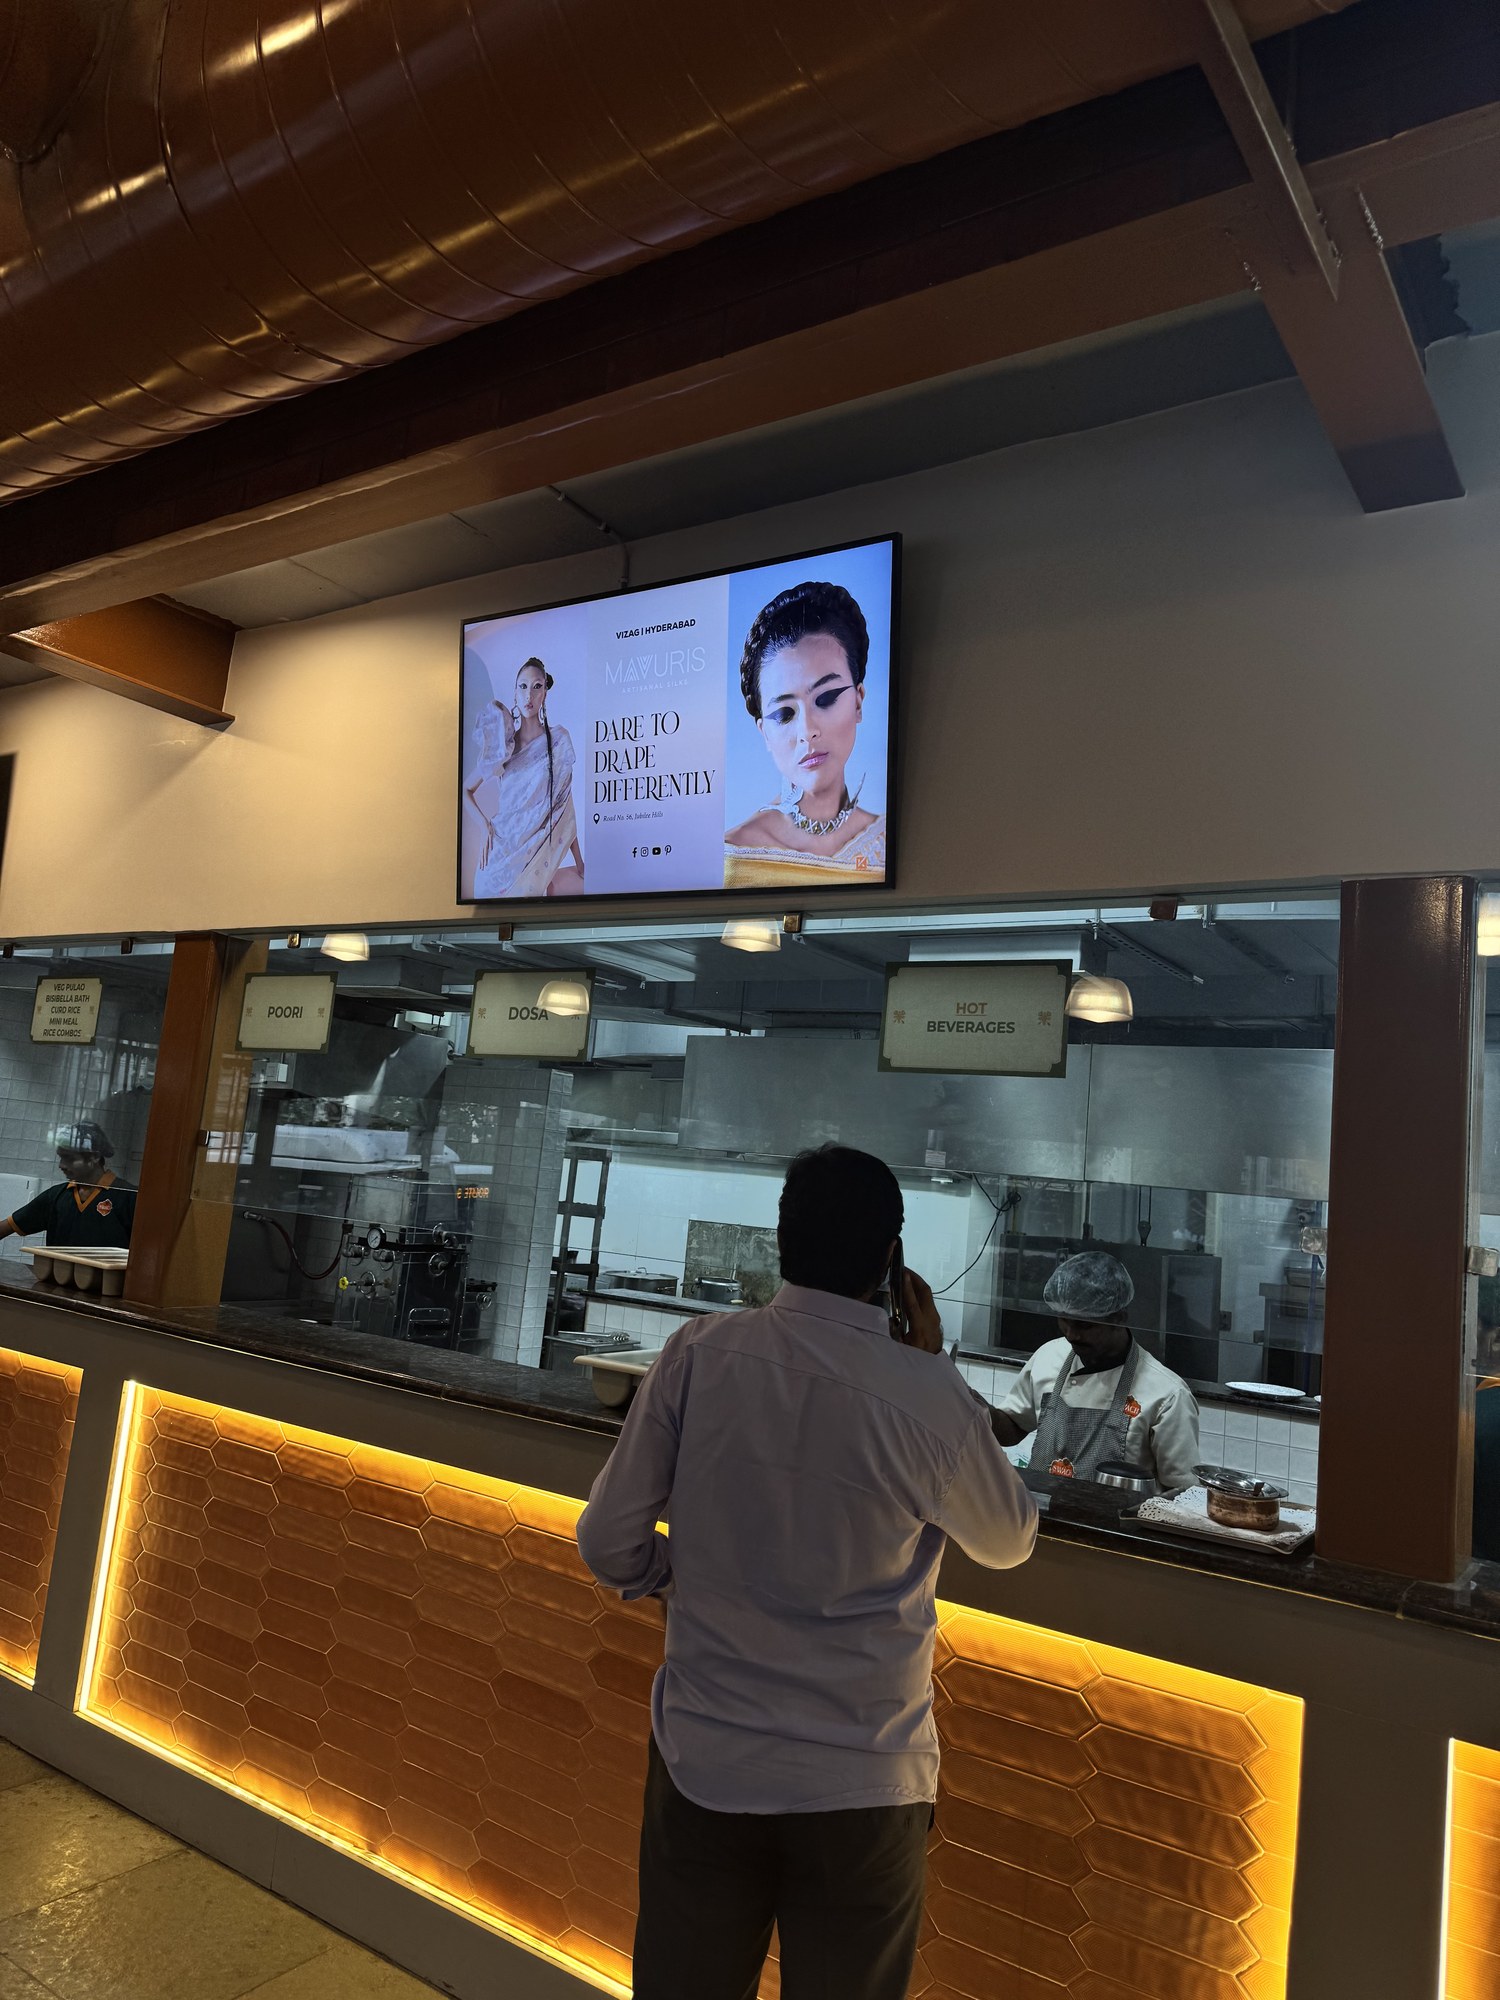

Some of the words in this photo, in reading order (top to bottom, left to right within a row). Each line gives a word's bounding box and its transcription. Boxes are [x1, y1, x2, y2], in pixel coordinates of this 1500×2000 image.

[616, 628, 640, 639] VIZAG
[645, 618, 696, 634] HYDERABAD
[605, 646, 706, 685] MAVURIS
[594, 715, 645, 743] DARE
[651, 710, 680, 736] TO
[594, 745, 656, 774] DRAPE
[594, 769, 716, 804] DIFFERENTLY
[53, 983, 65, 991] VEG
[66, 983, 86, 991] PULAO
[45, 995, 73, 1003] BISIBELLA
[74, 995, 90, 1003] BATH
[50, 1006, 67, 1014] CURD
[67, 1006, 81, 1014] RICE
[267, 1005, 304, 1020] POORI
[508, 1006, 549, 1021] DOSA
[956, 1002, 988, 1015] HOT
[49, 1017, 62, 1025] MINI
[926, 1020, 1016, 1034] BEVERAGES
[42, 1029, 56, 1037] RICE
[56, 1029, 82, 1037] COMBOS
